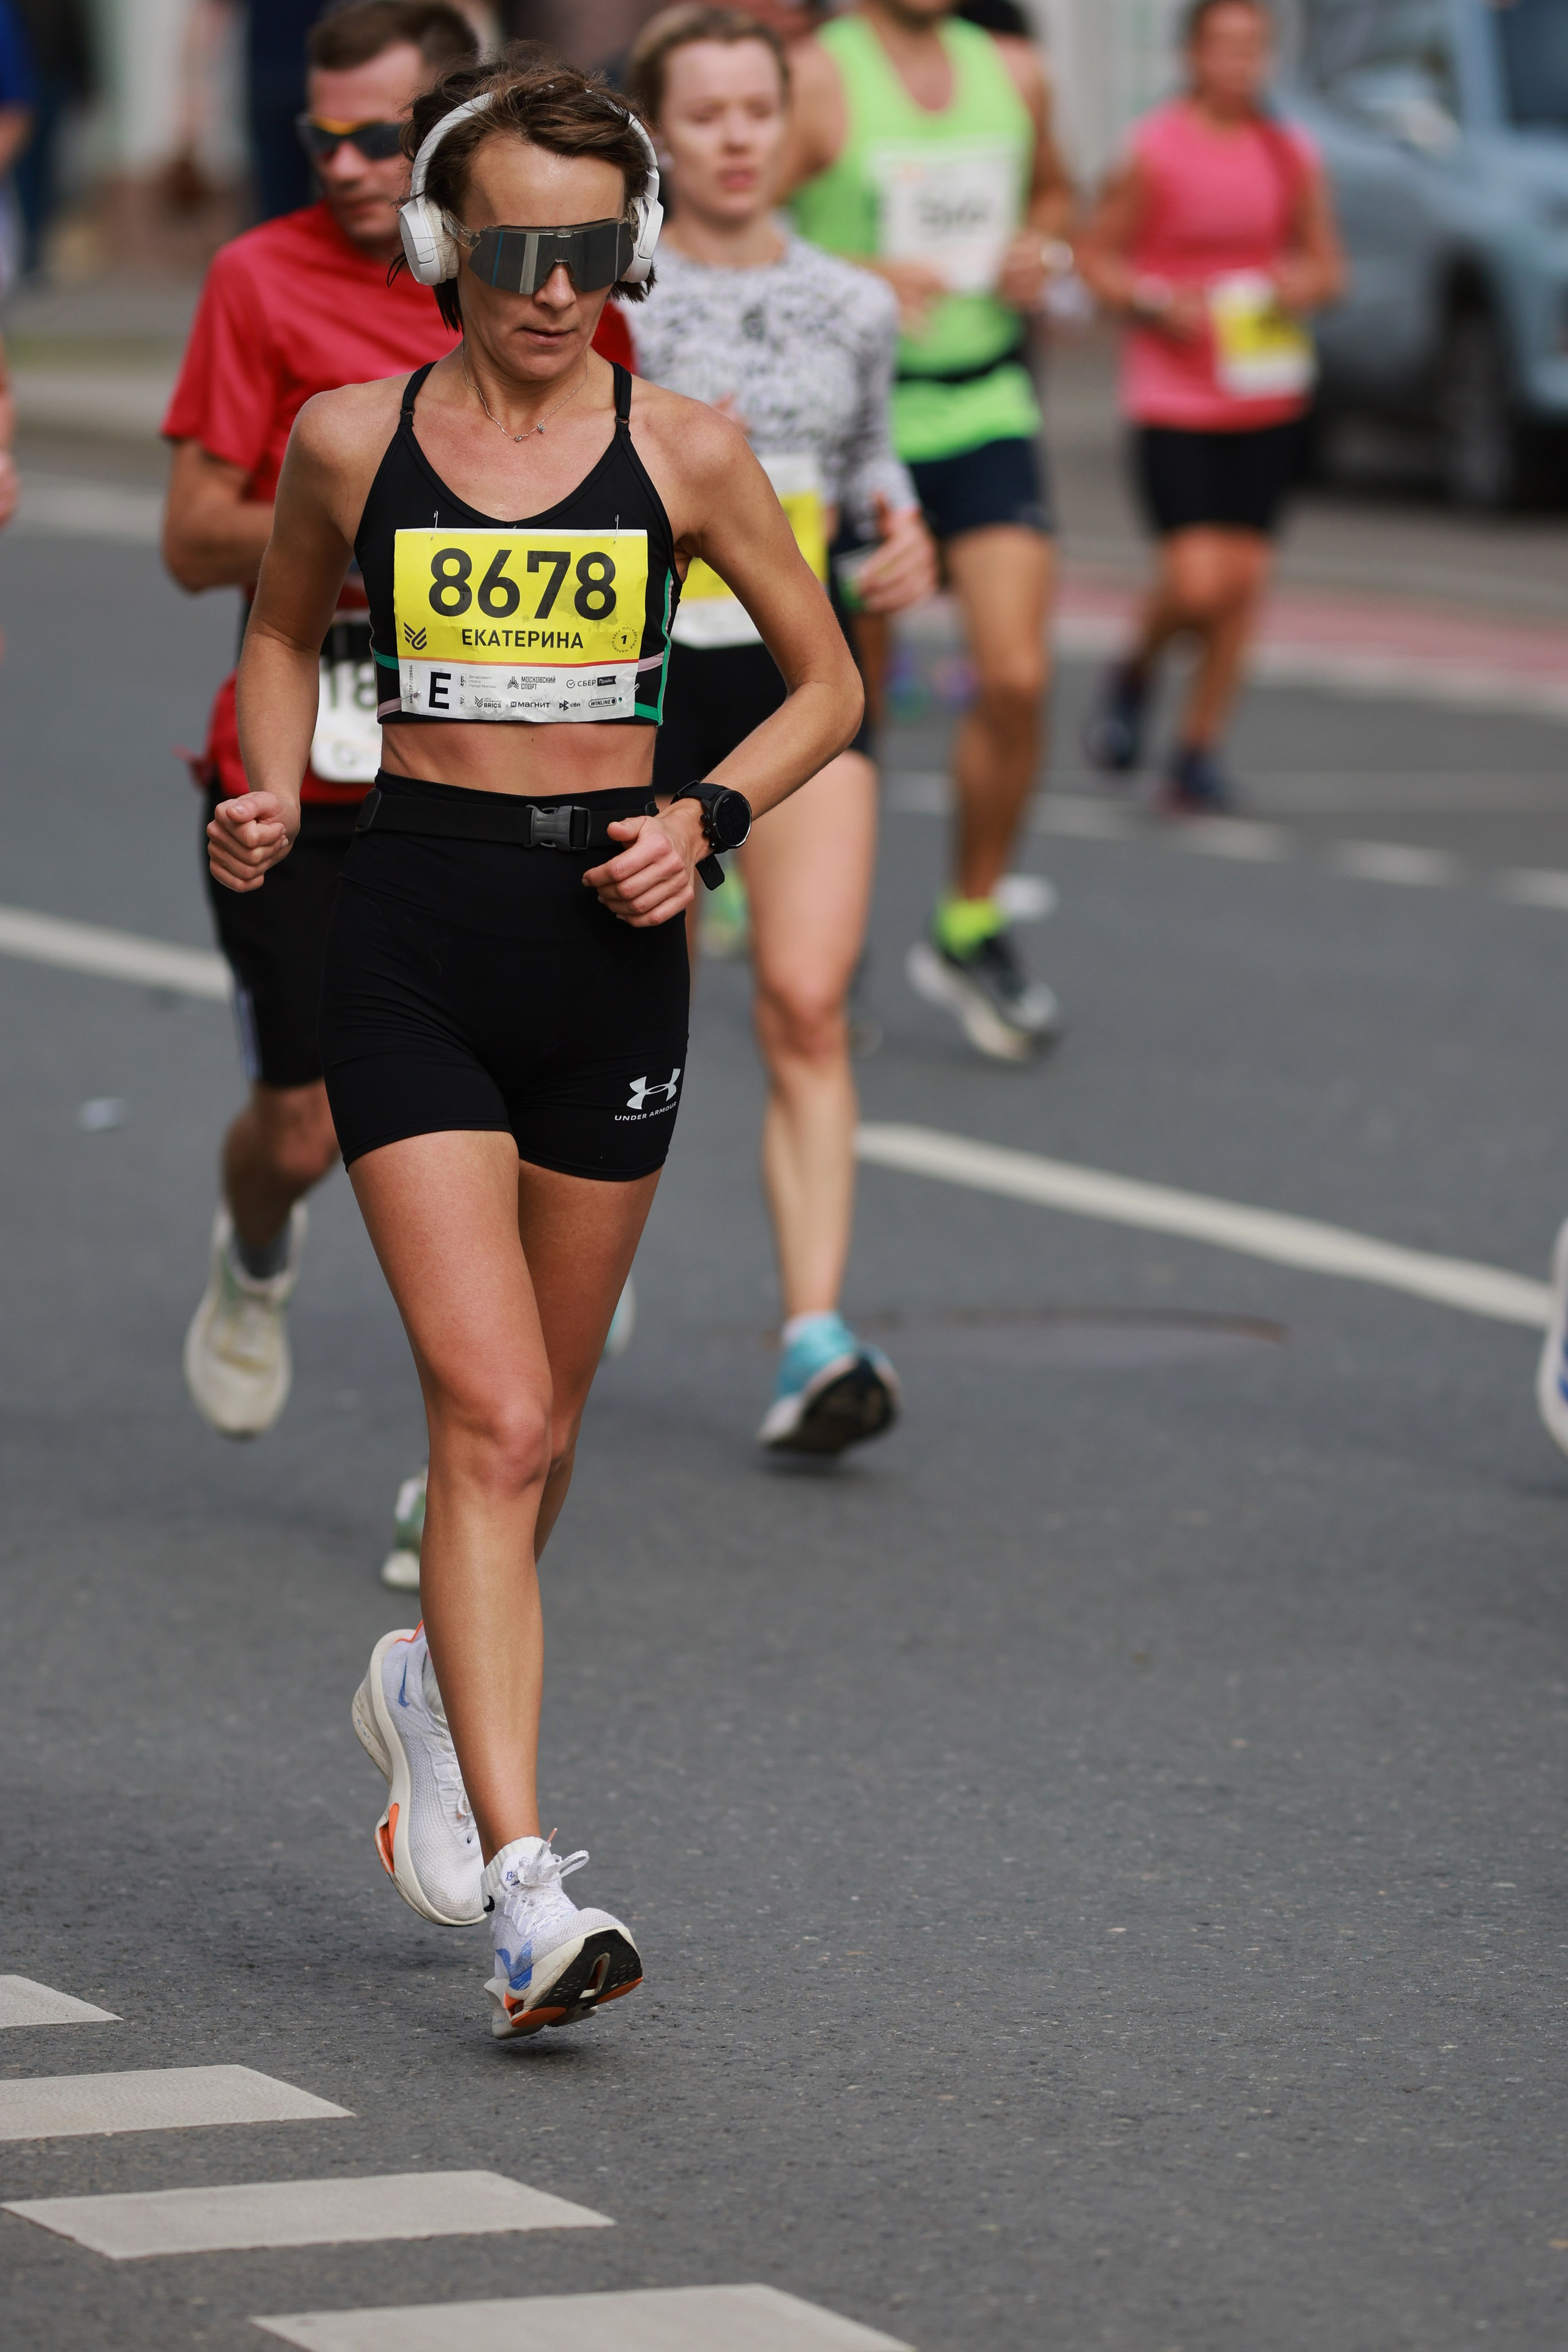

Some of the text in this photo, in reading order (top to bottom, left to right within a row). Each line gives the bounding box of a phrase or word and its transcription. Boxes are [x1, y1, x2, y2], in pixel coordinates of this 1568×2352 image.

[428, 548, 617, 621] 8678
[461, 628, 584, 649] ЕКАТЕРИНА
[620, 635, 628, 645] 1
[521, 675, 556, 684] МОСКОВСКИЙ
[649, 1101, 677, 1117] ARMOUR
